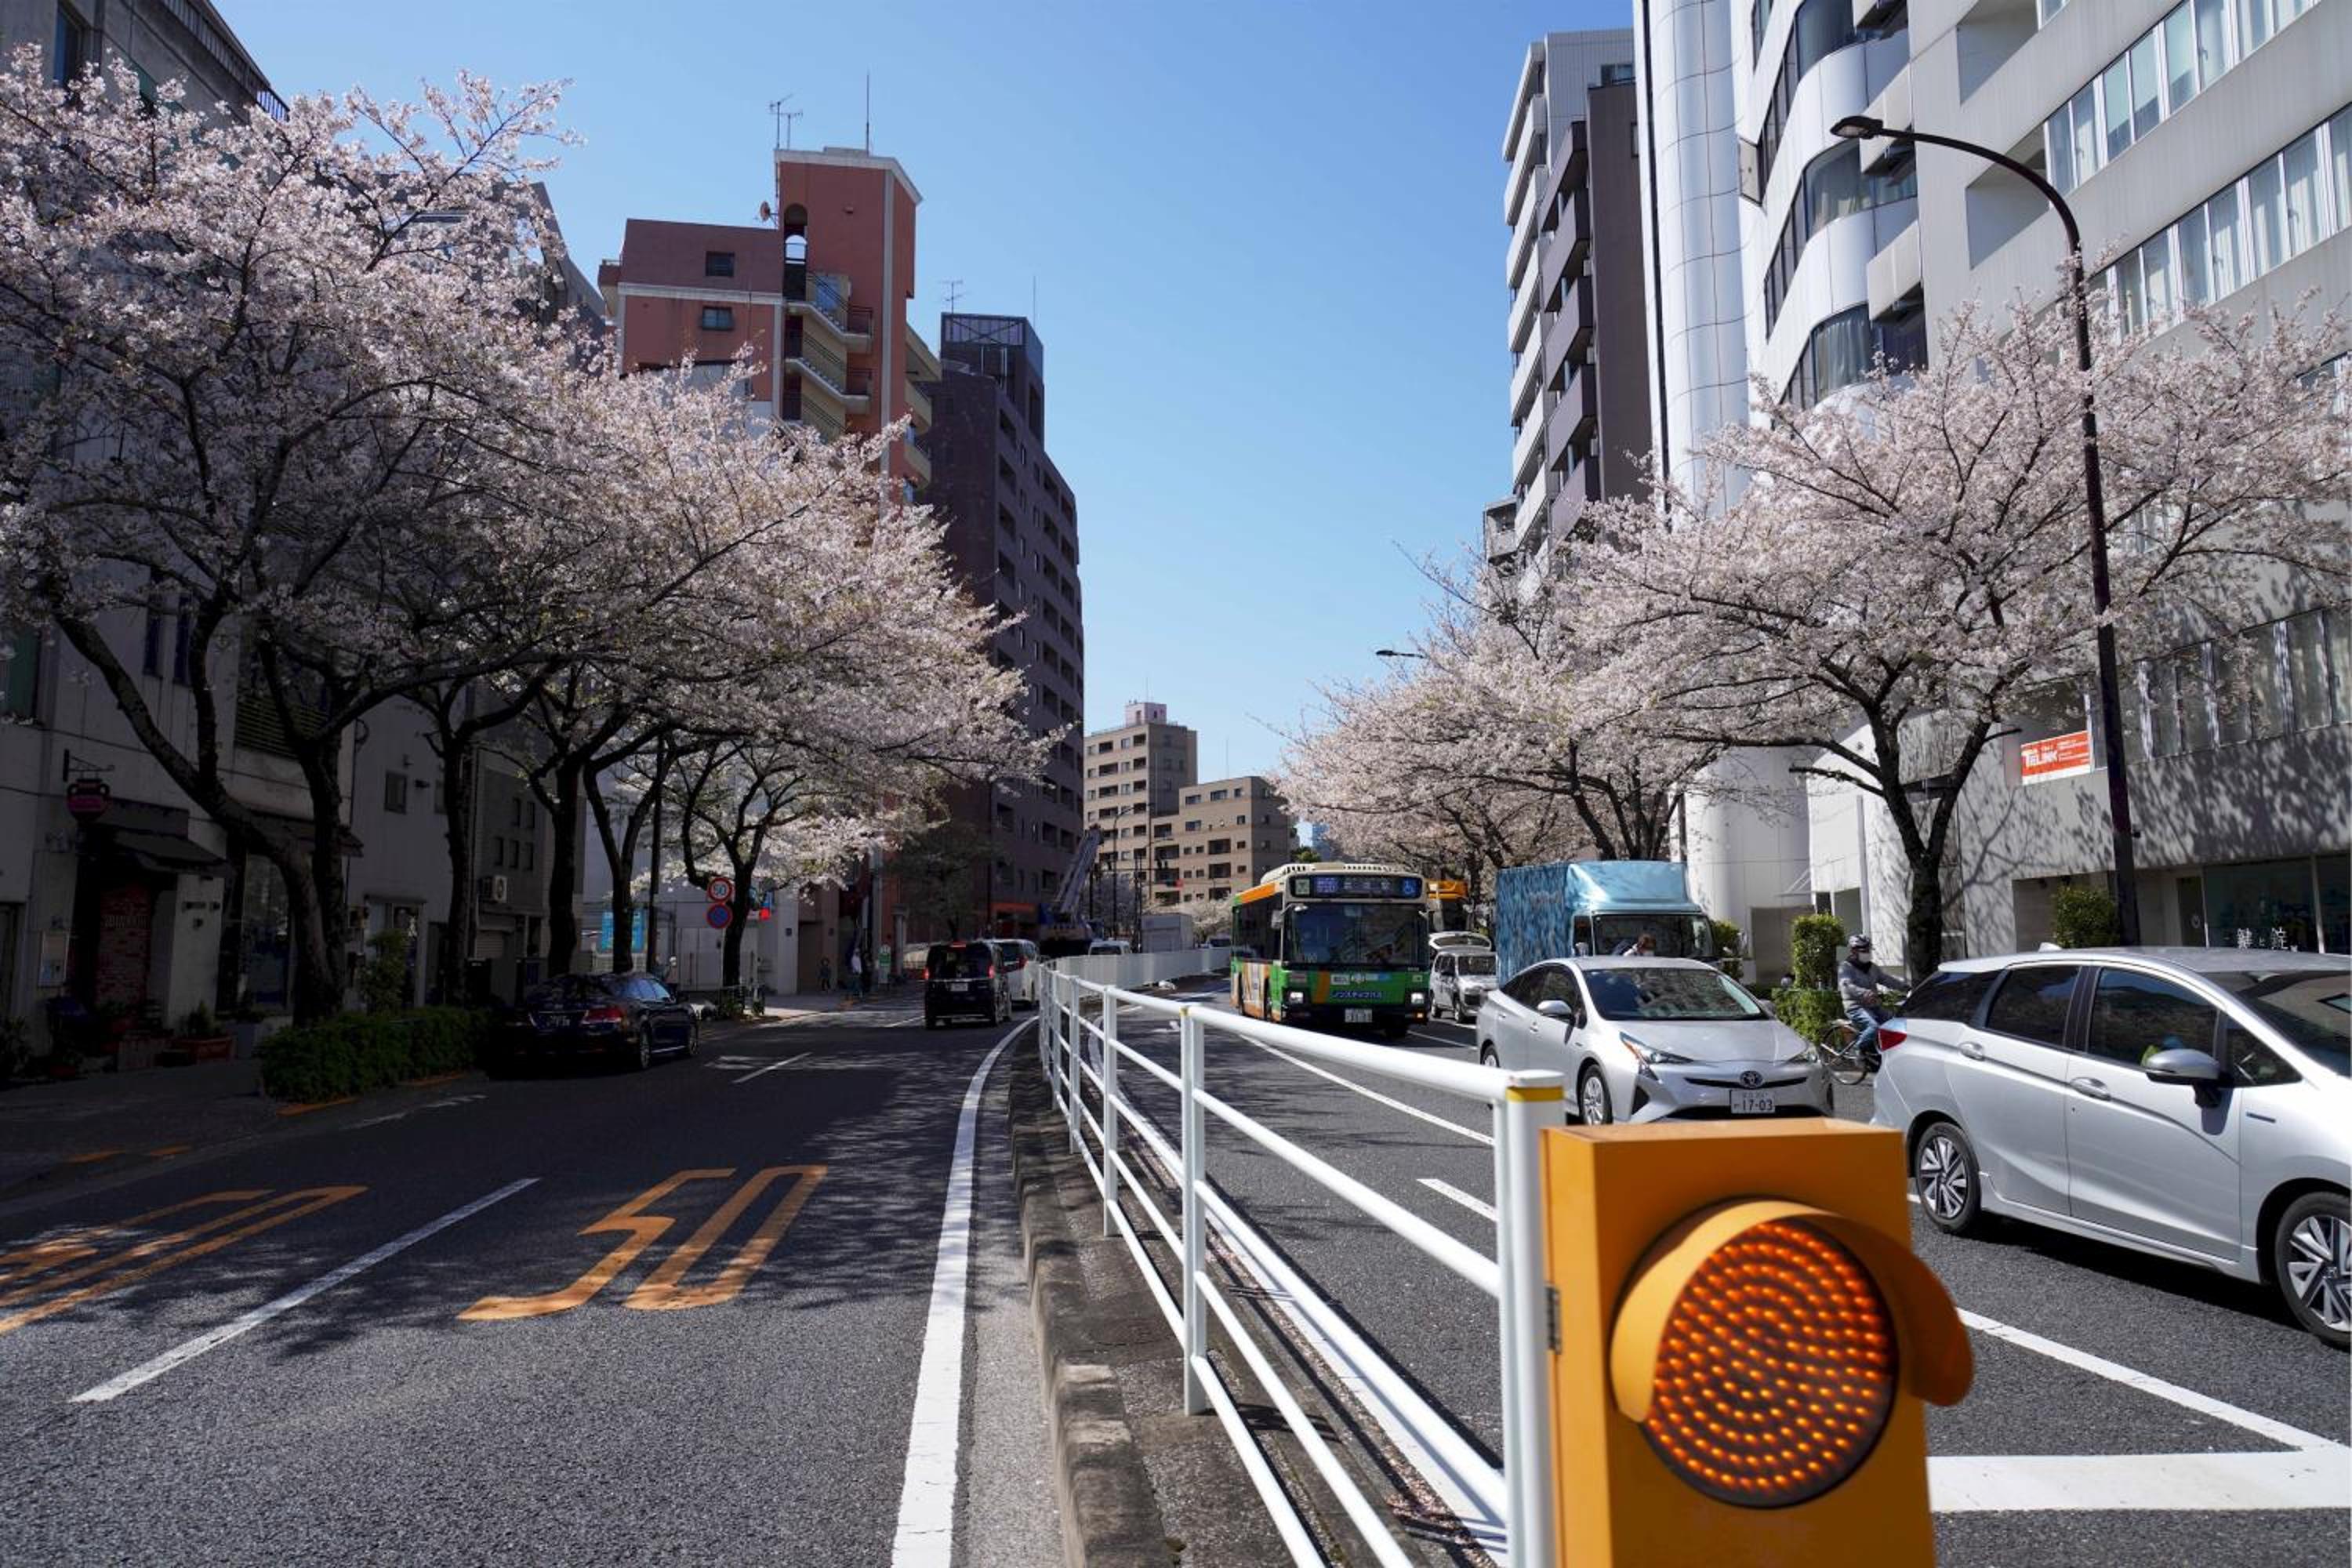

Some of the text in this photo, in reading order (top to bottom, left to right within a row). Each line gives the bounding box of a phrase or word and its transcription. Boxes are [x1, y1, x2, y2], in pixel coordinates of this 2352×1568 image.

[714, 884, 727, 895] 50
[1743, 1099, 1773, 1111] 17-03
[456, 1164, 828, 1320] 50
